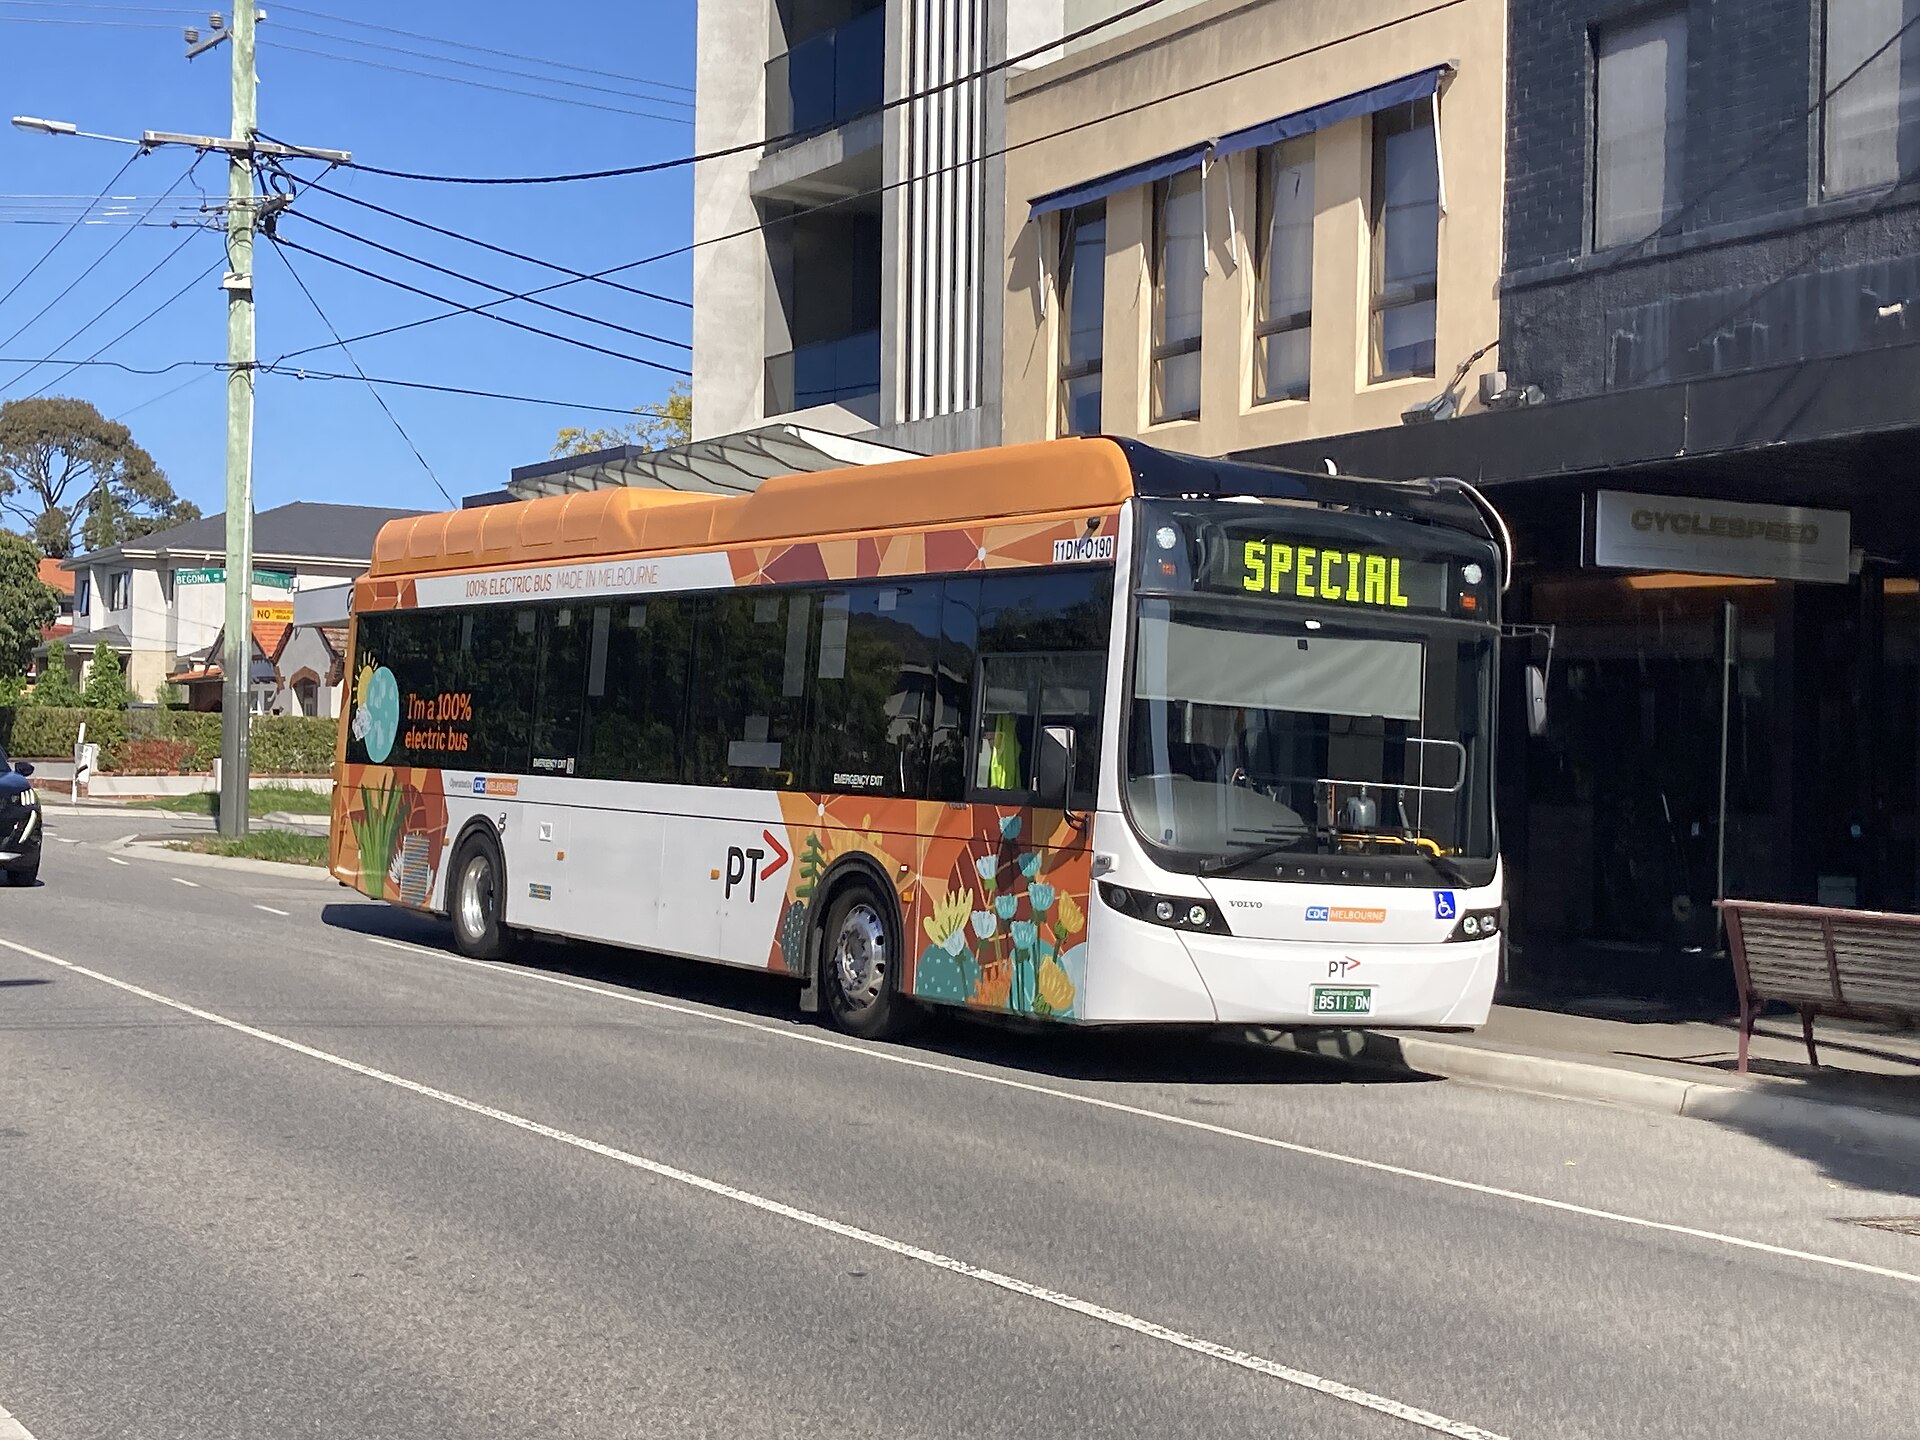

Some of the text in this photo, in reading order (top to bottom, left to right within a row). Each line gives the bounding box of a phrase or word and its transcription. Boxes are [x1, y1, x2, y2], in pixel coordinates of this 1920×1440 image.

[1631, 509, 1820, 545] CYCLESPEED
[176, 574, 211, 585] BEGONIA
[466, 564, 659, 597] 100% ELECTRIC BUS MADE IN MELBOURNE
[1243, 541, 1408, 607] SPECIAL
[257, 609, 271, 619] NO
[407, 693, 472, 721] I'm a 100%
[405, 725, 469, 751] electric bus
[833, 773, 884, 786] EMERGENCY EXIT
[725, 846, 765, 903] PT
[1229, 900, 1263, 909] VOLVO
[1306, 907, 1385, 921] CDC MELBOURNE
[1328, 961, 1348, 978] PT
